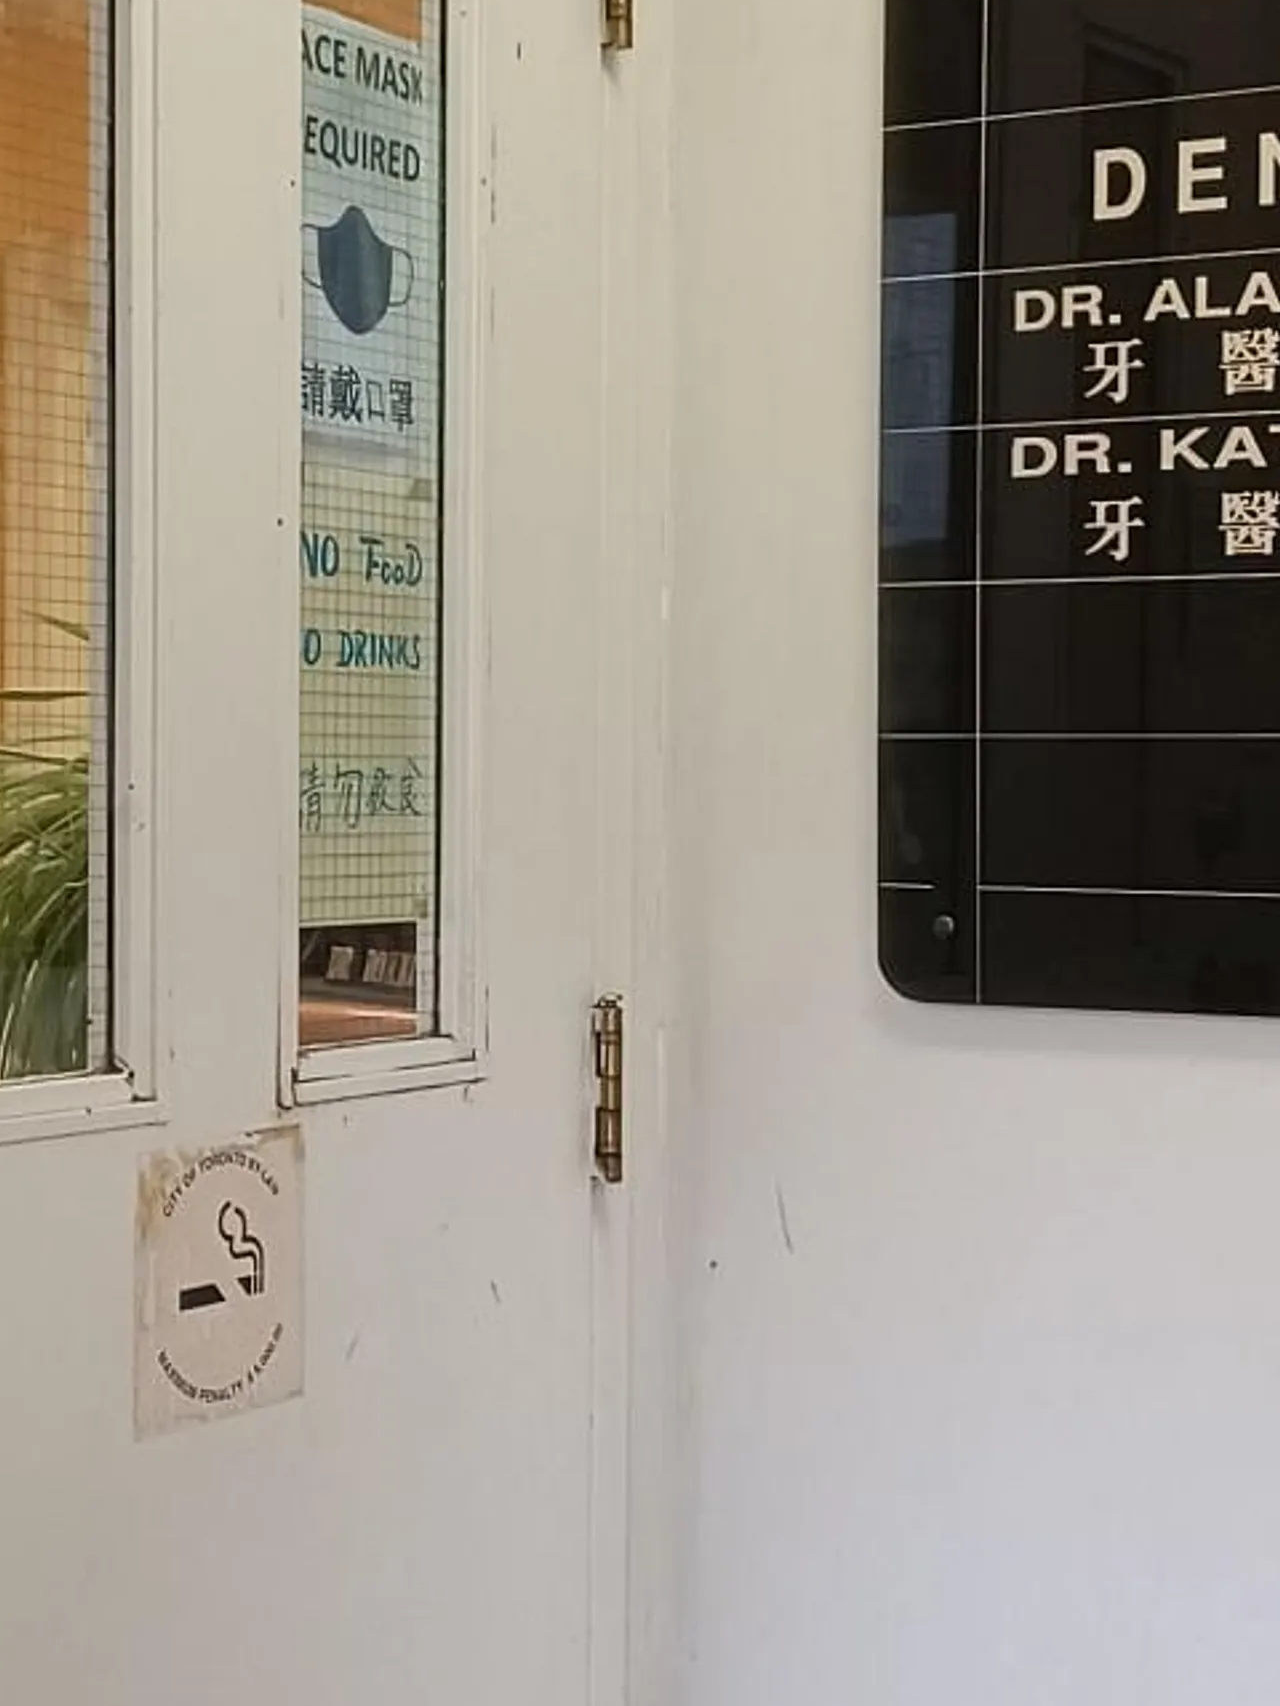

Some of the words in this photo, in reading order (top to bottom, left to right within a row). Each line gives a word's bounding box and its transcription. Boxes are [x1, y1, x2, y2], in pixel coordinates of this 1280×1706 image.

[301, 28, 348, 79] ACE
[304, 113, 420, 181] EQUIRED
[1014, 285, 1122, 332] DR.
[1011, 433, 1132, 478] DR.
[300, 530, 340, 578] NO
[303, 628, 322, 665] O
[335, 629, 421, 670] DRINKS
